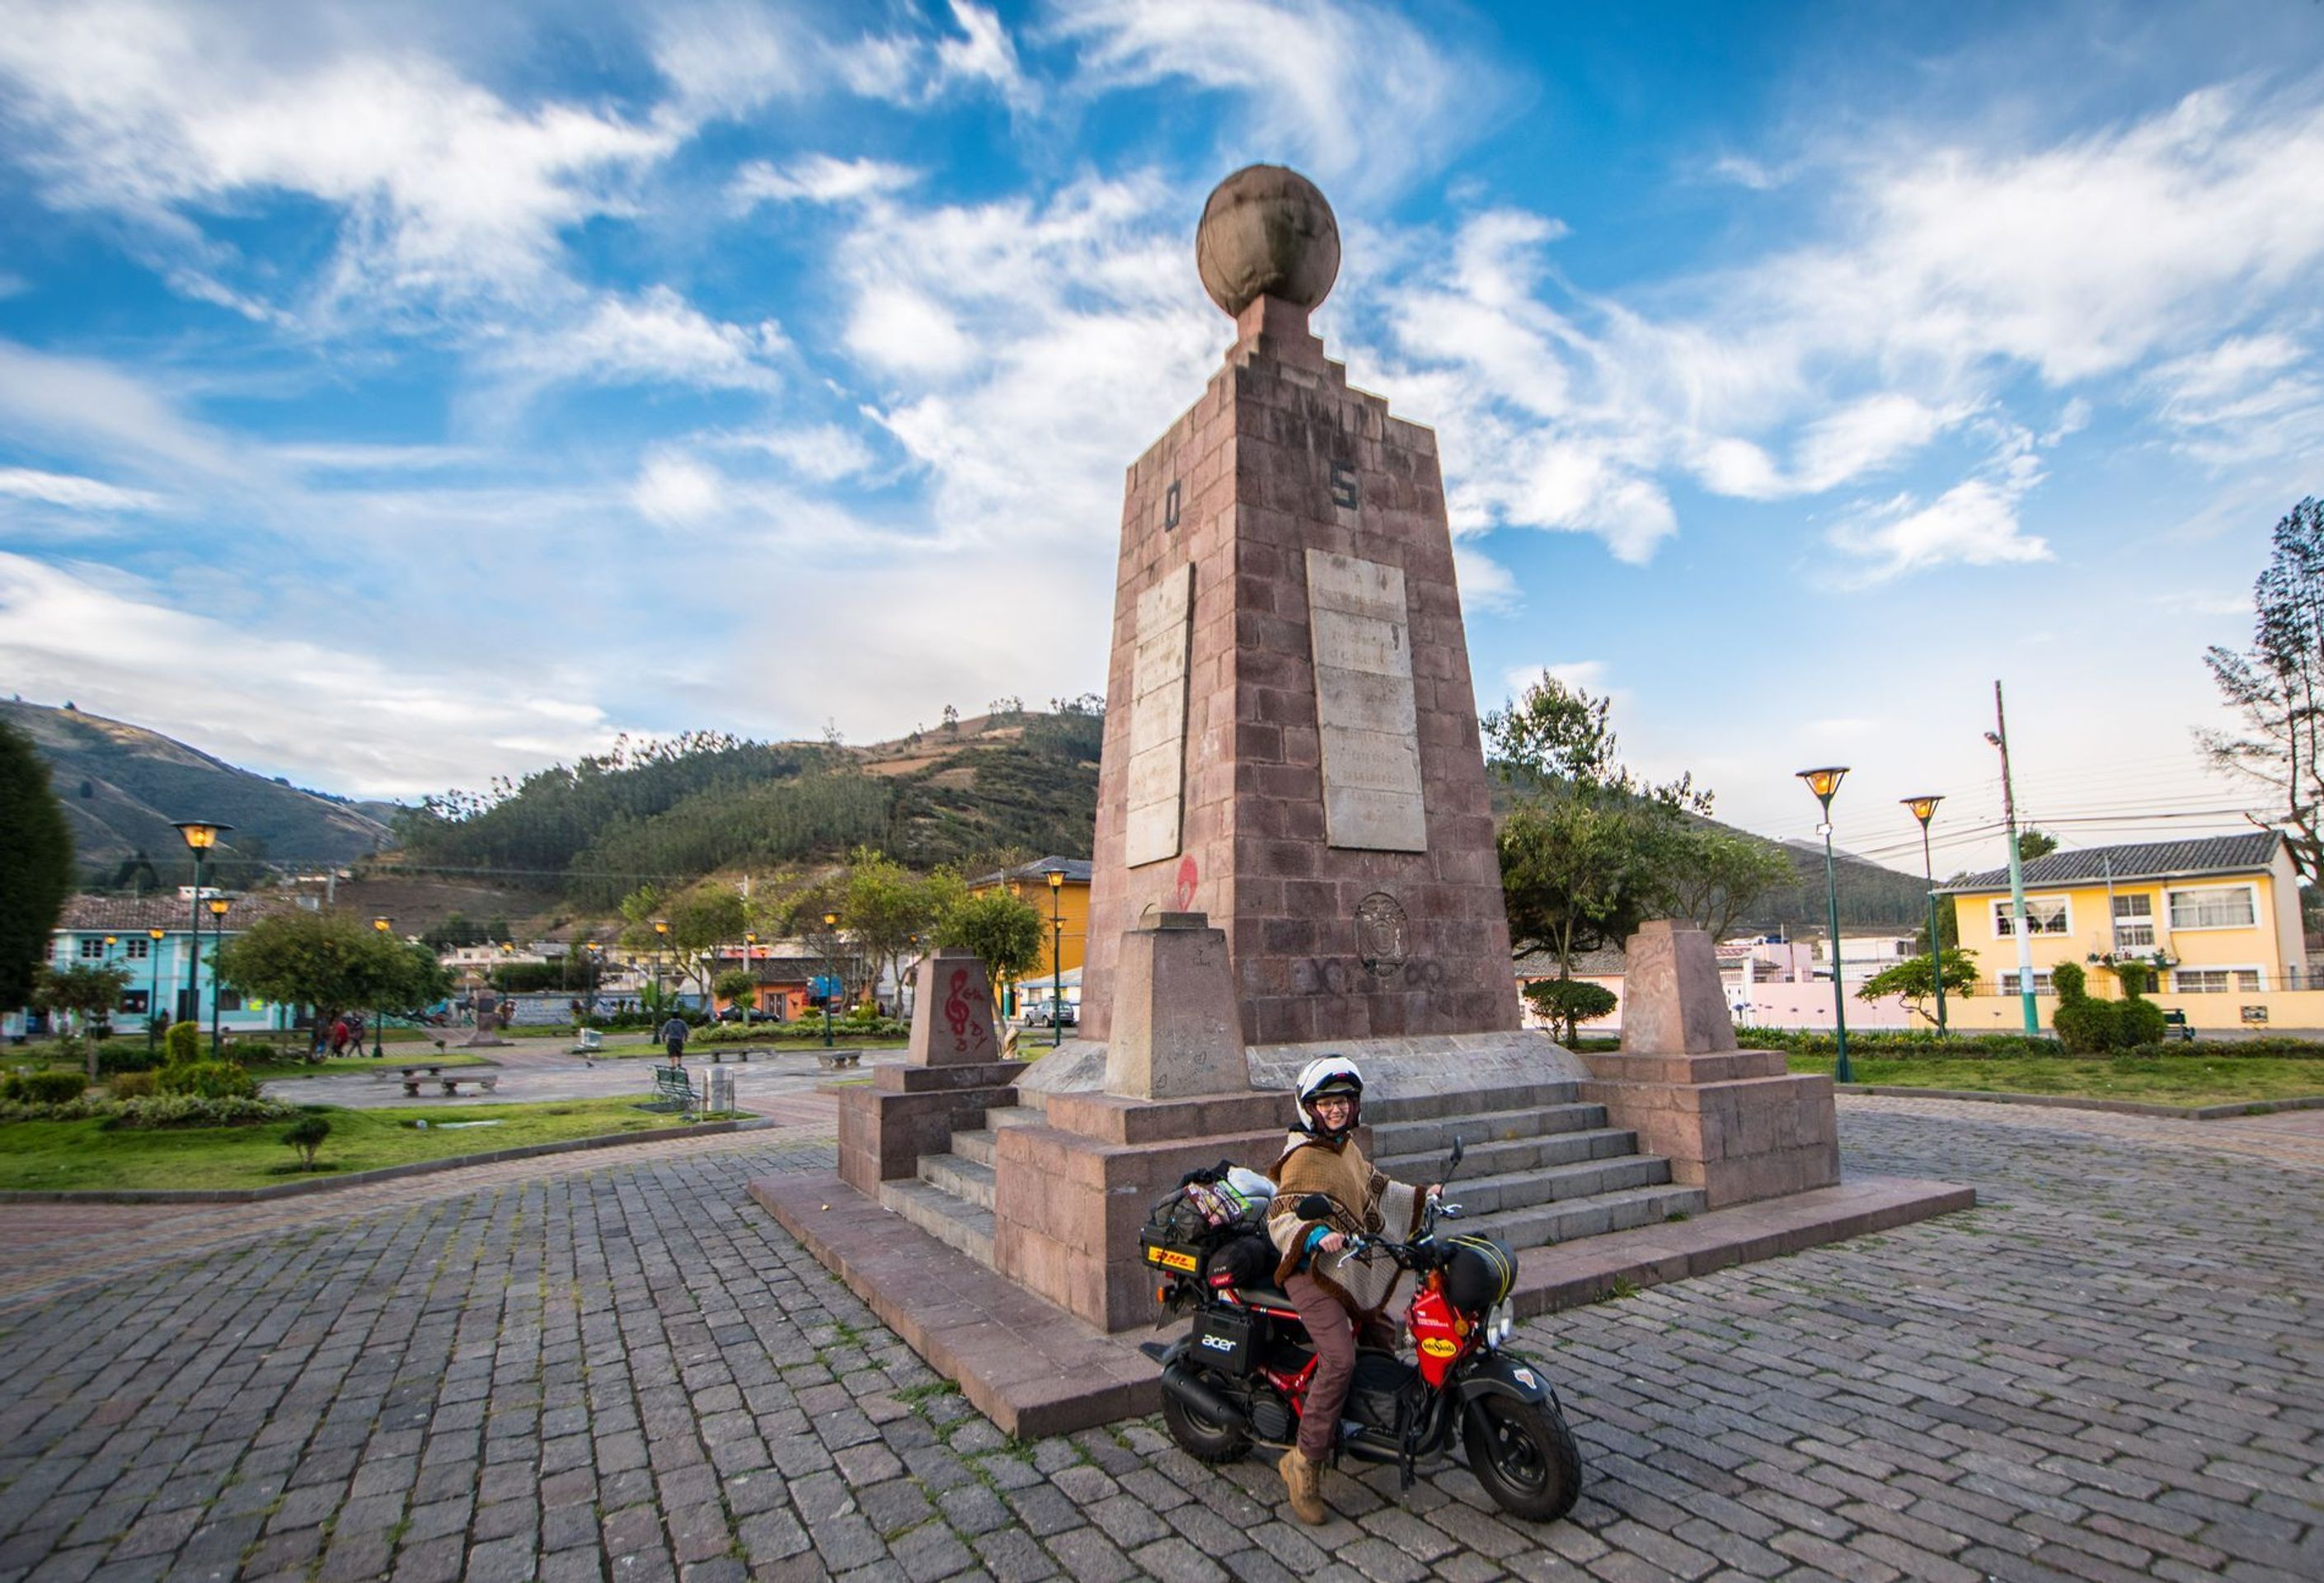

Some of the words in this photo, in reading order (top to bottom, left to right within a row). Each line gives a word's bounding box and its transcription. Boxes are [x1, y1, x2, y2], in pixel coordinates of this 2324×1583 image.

[1331, 460, 1358, 511] S
[1155, 1250, 1189, 1266] DHL
[1201, 1333, 1237, 1352] acer
